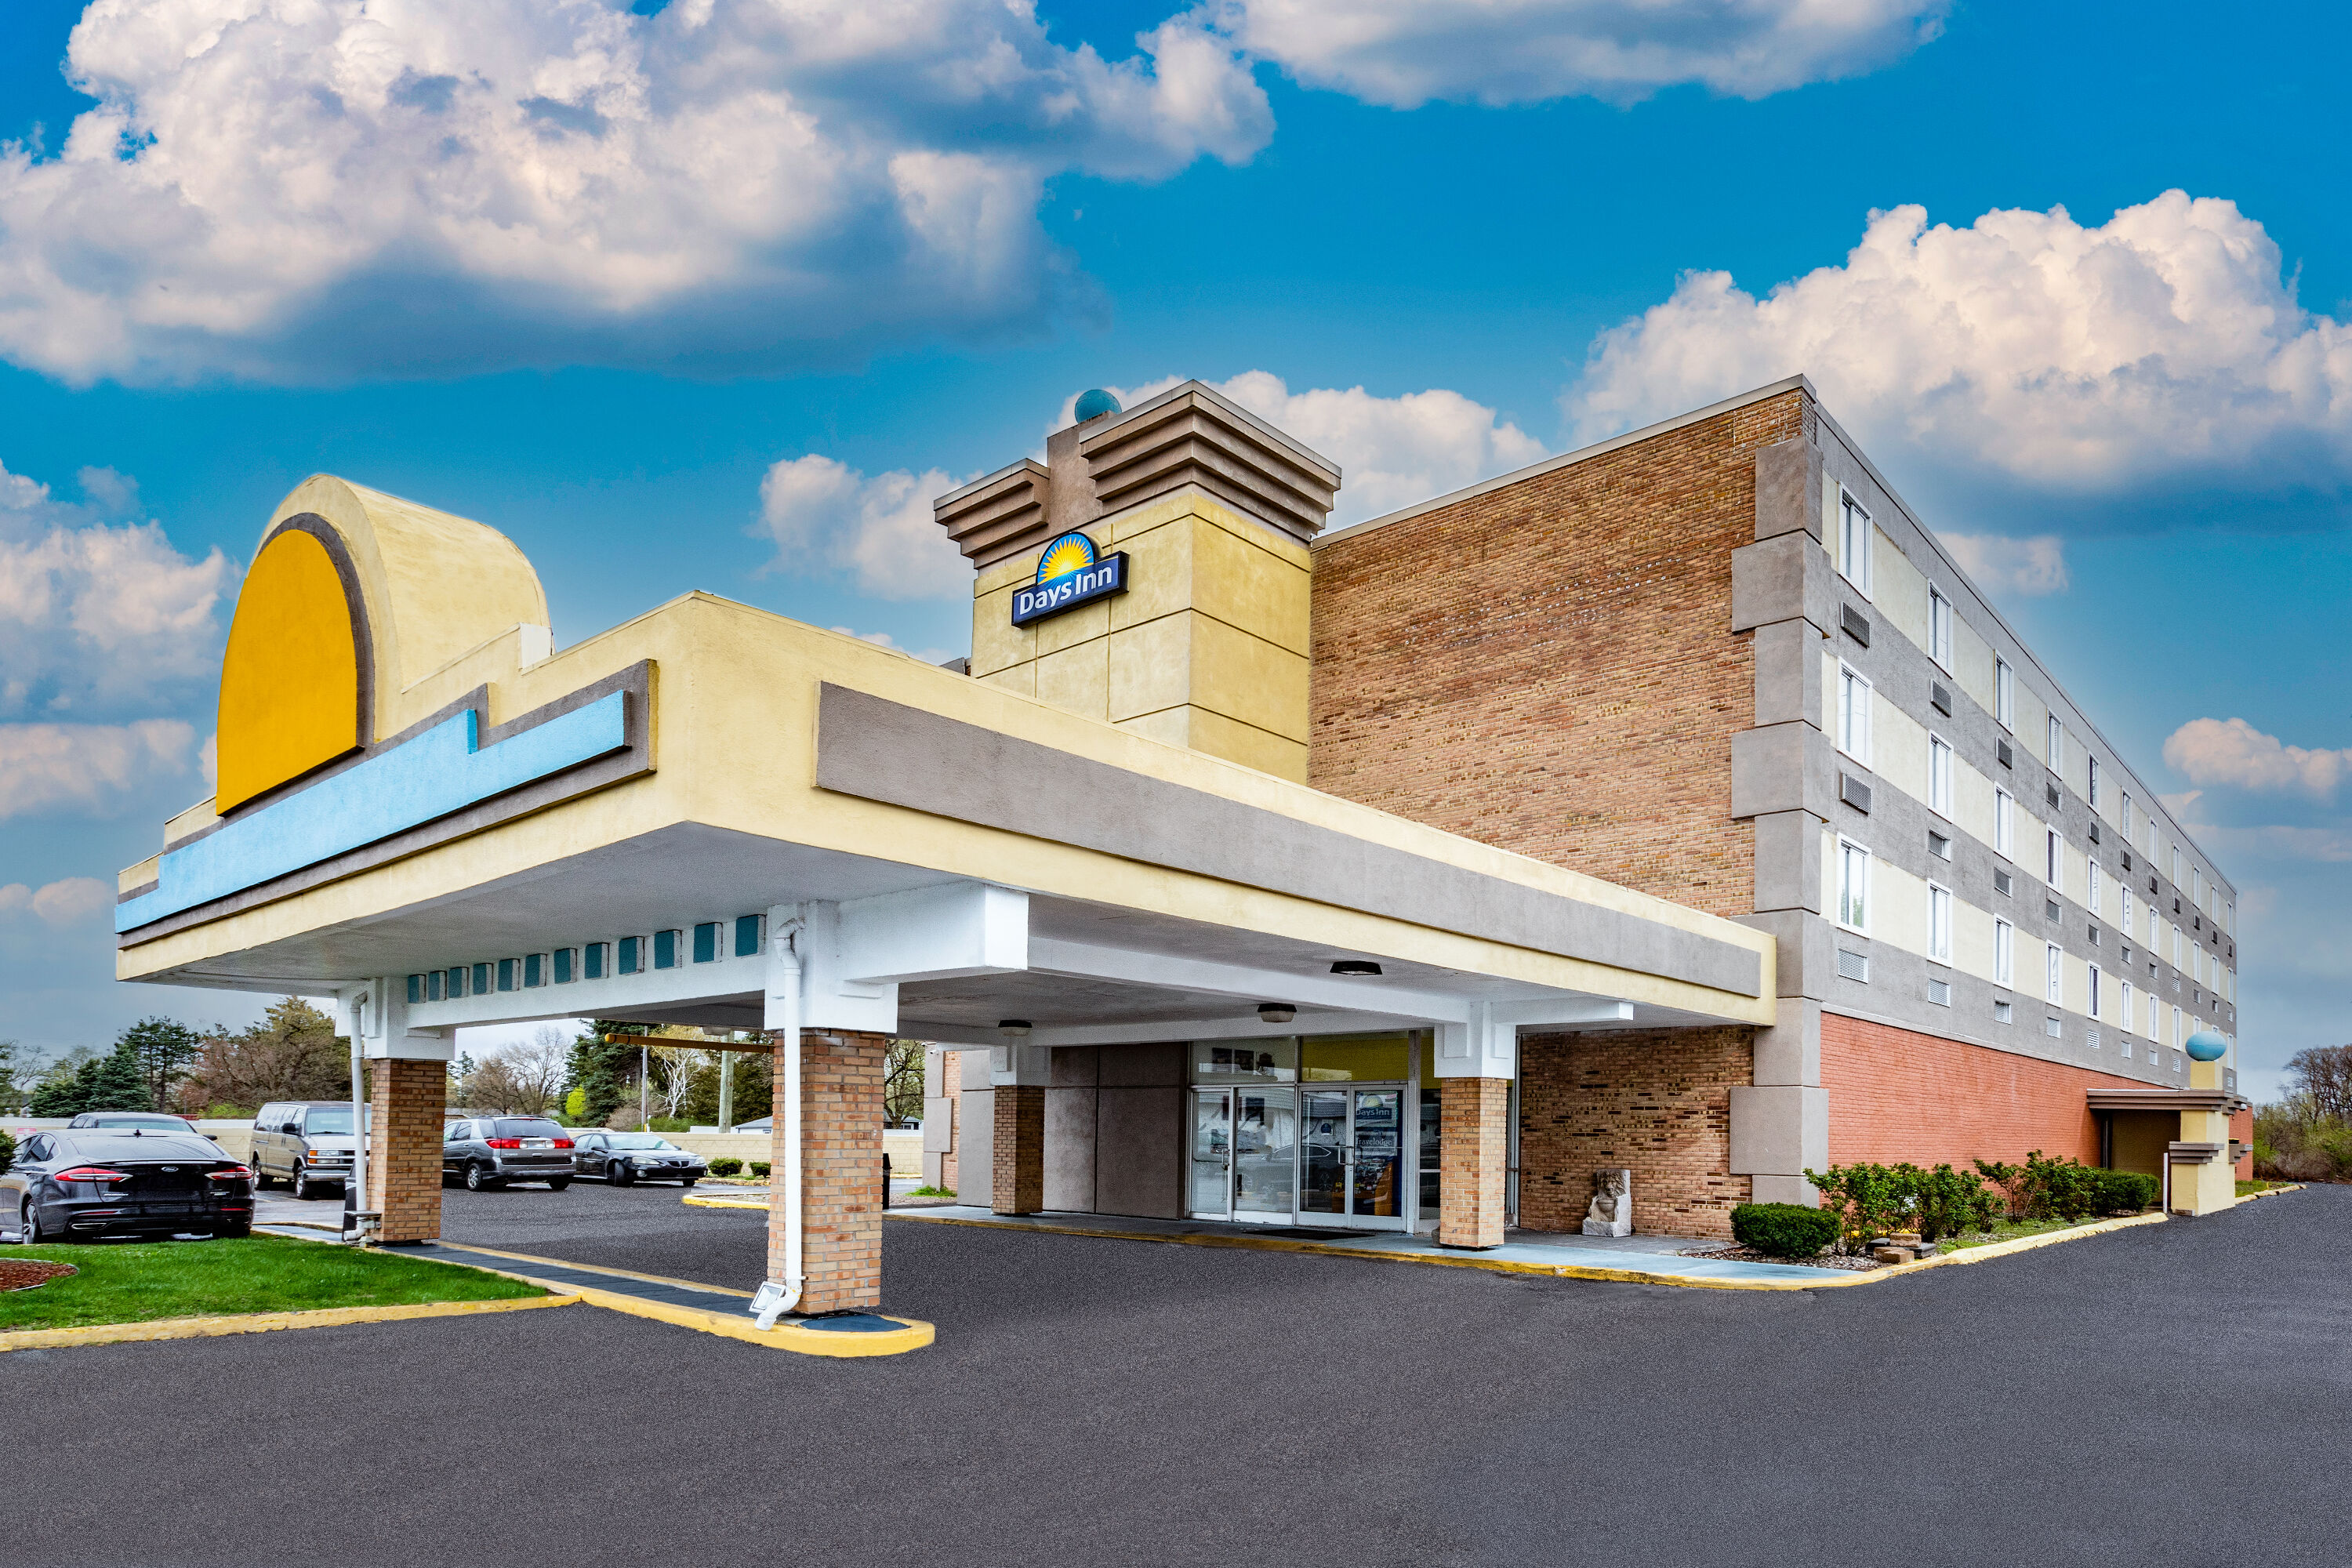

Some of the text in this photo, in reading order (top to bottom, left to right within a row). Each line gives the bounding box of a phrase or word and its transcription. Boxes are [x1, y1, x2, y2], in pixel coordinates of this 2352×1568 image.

[1019, 566, 1112, 615] Days Inn
[1356, 1137, 1392, 1147] Travelodge
